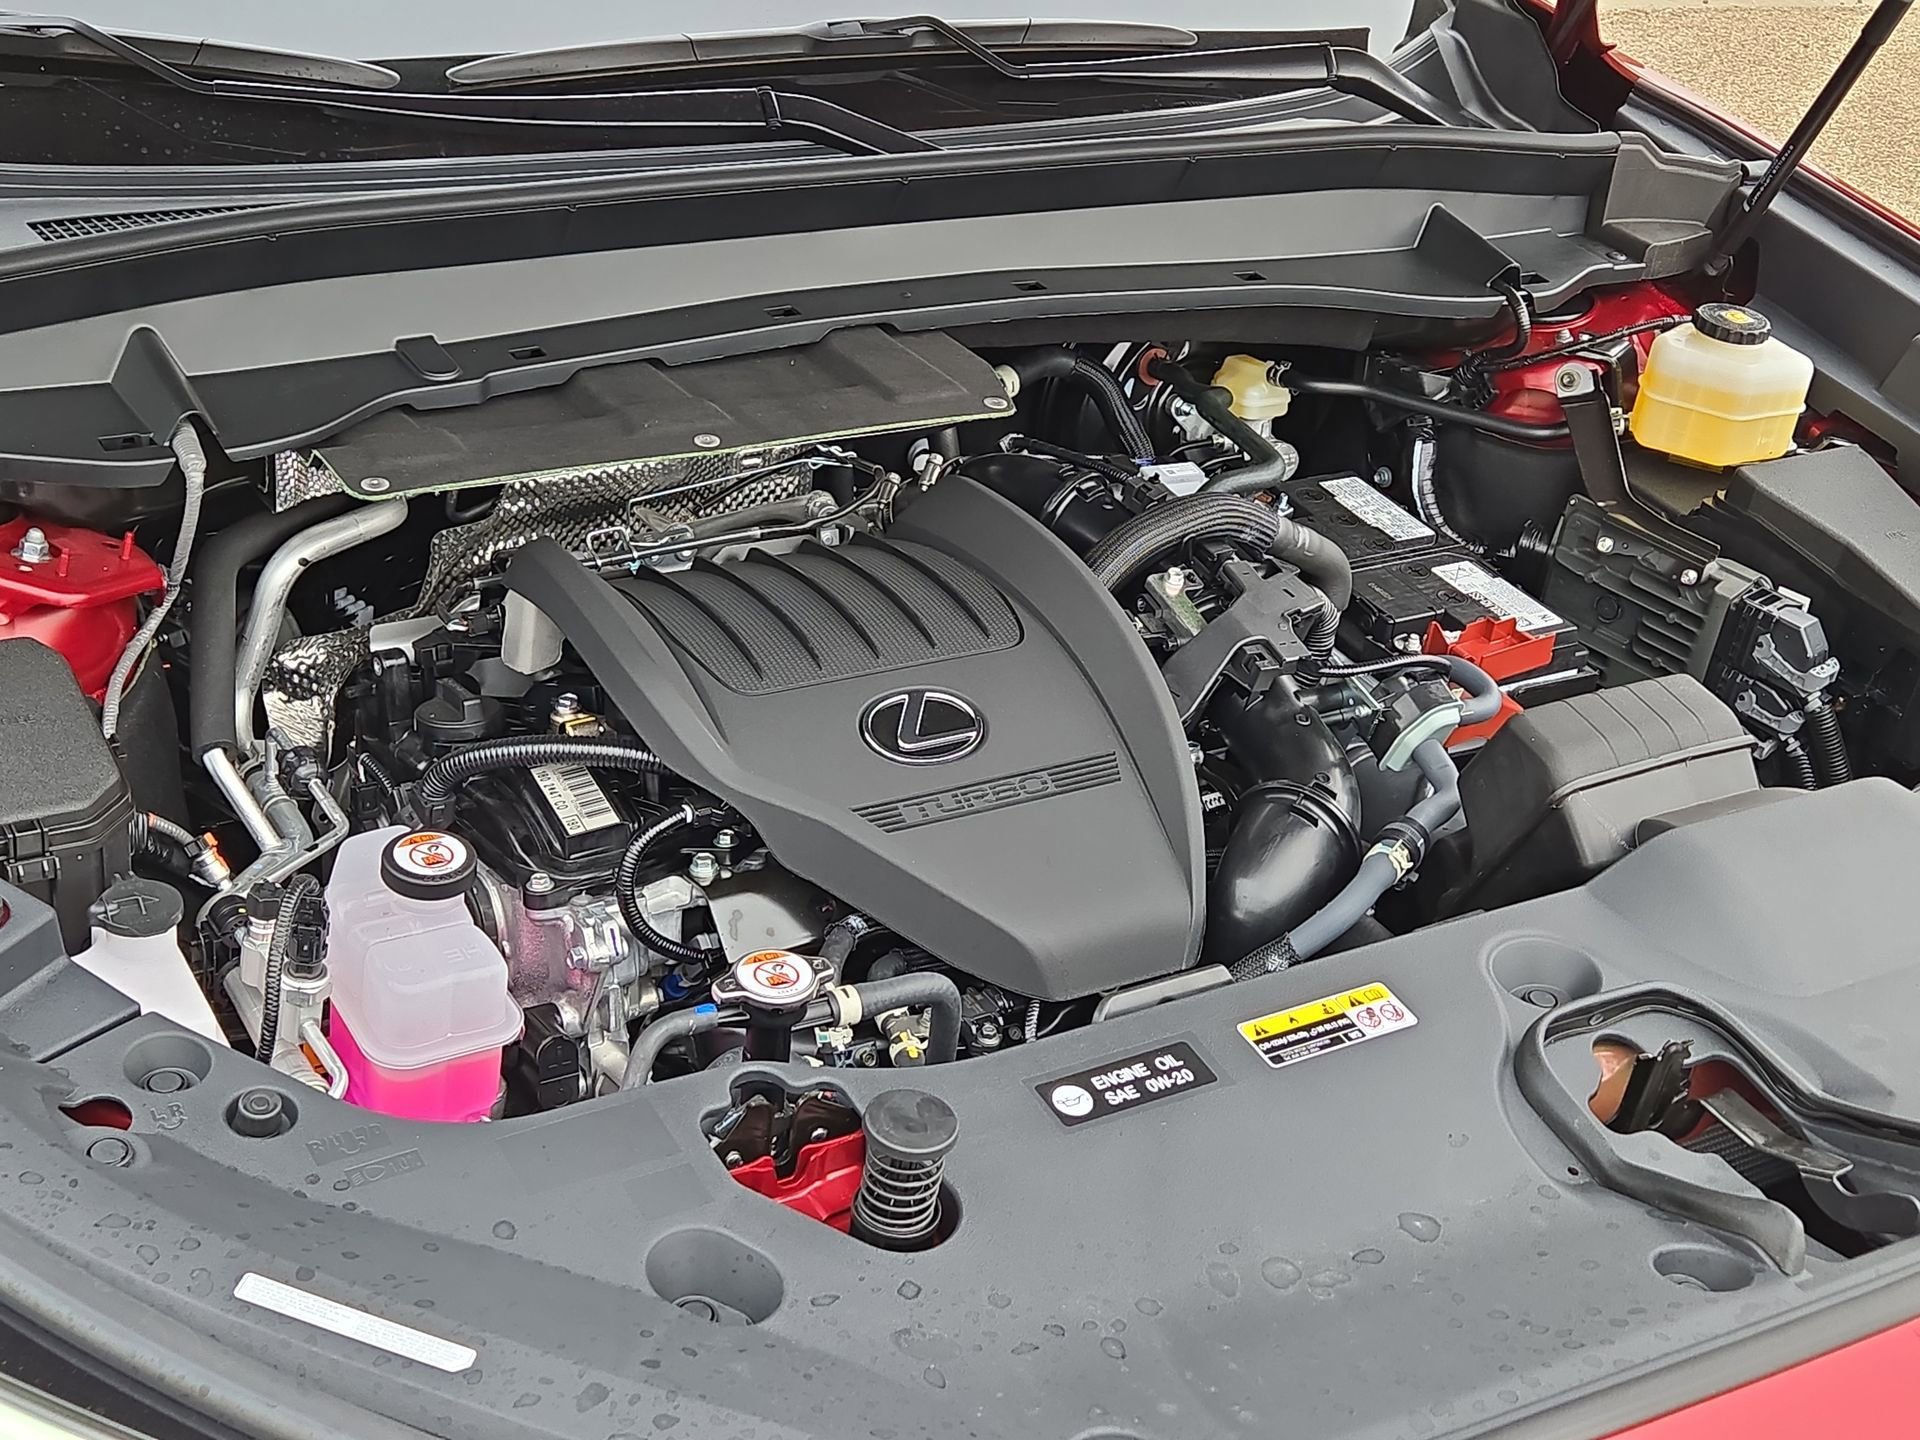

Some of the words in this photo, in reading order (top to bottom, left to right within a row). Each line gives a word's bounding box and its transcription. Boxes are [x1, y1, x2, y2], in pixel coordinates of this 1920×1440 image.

[901, 772, 1051, 820] TURBO
[1090, 1062, 1151, 1091] ENGINE
[1154, 1053, 1185, 1071] OIL
[1104, 1084, 1142, 1106] SAE
[1145, 1068, 1195, 1094] 0W-20
